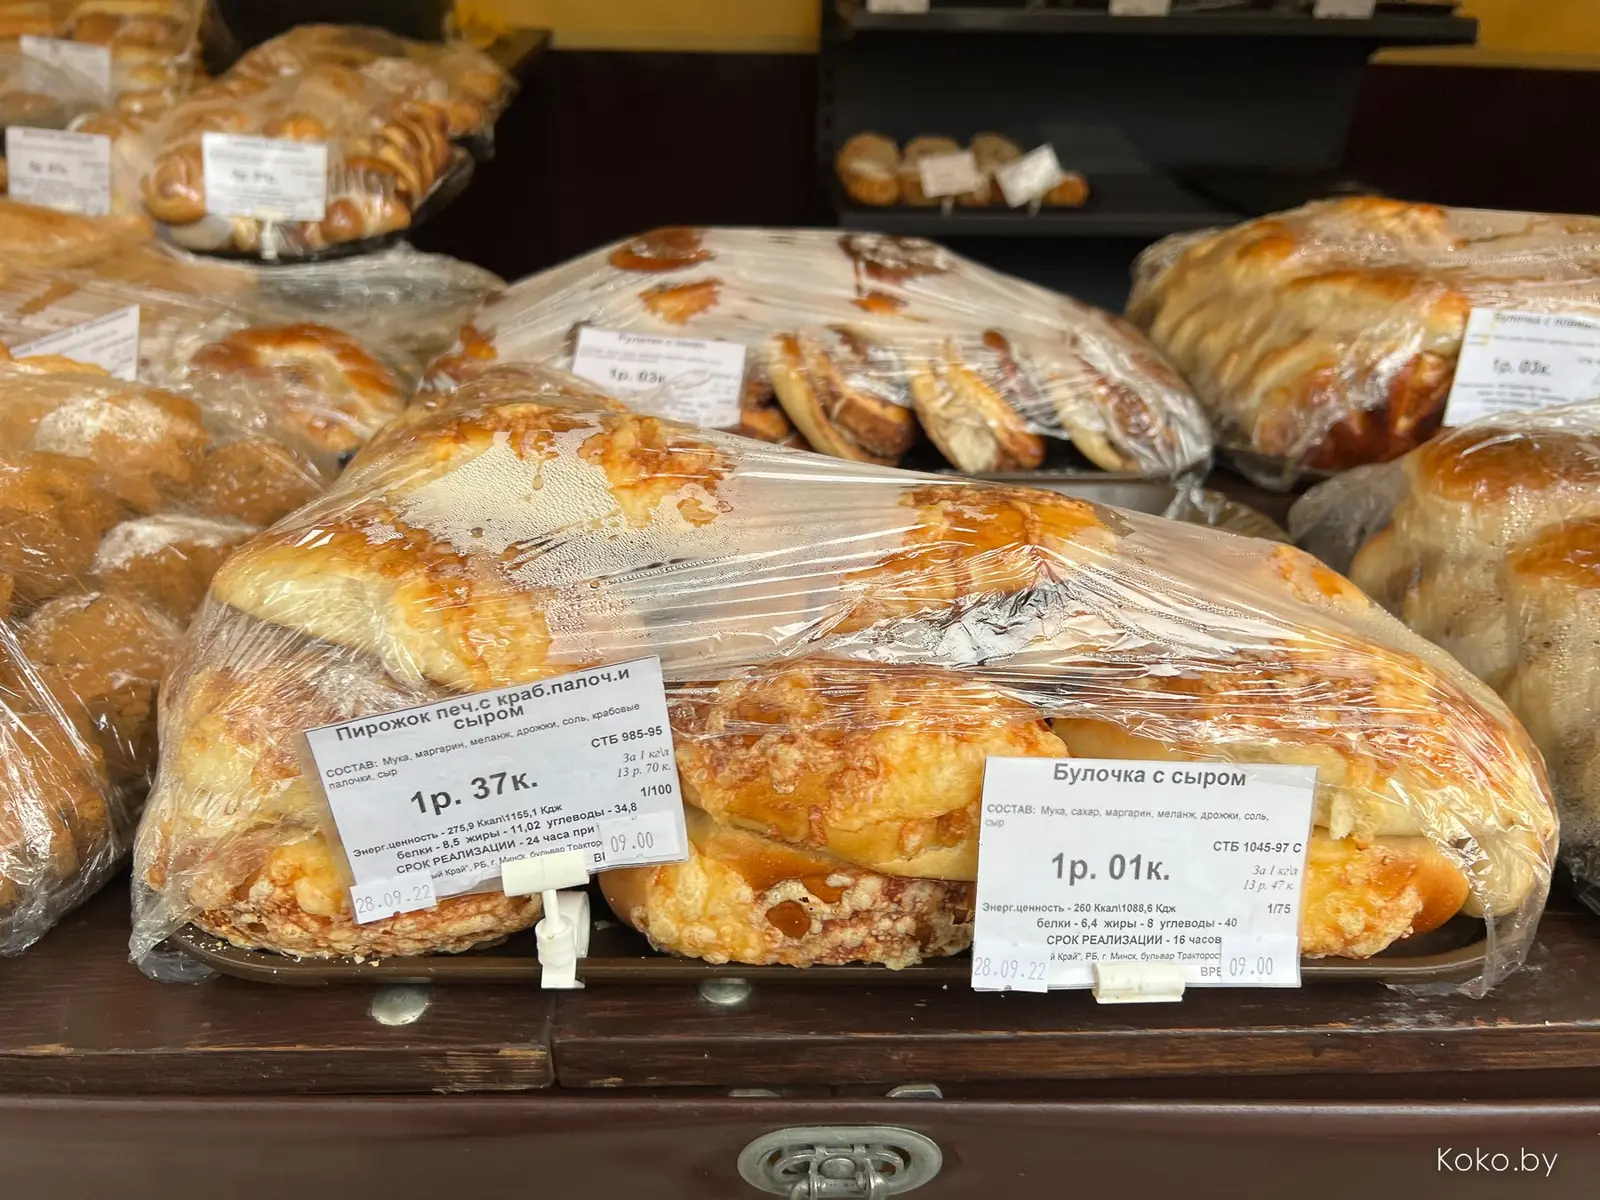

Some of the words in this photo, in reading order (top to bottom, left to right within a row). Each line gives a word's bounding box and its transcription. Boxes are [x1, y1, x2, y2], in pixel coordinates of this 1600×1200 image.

[336, 711, 431, 741] Пирожок
[436, 698, 491, 720] печ.с
[497, 669, 630, 706] краб.палоч.и
[454, 706, 524, 730] сыром
[326, 760, 378, 778] СОСТАВ:
[382, 753, 412, 767] Мука,
[415, 741, 468, 760] маргарин,
[470, 731, 513, 747] меланж,
[562, 714, 589, 726] соль,
[592, 703, 640, 720] крабовые
[591, 734, 618, 748] СТБ
[622, 726, 663, 742] 985-95
[623, 753, 636, 763] За
[640, 750, 644, 760] 1
[377, 768, 397, 779] сыр
[618, 768, 629, 778] 13
[633, 768, 642, 779] р.
[646, 763, 659, 773] 70
[662, 763, 671, 772] к.
[1053, 763, 1146, 785] Булочка
[1153, 770, 1165, 784] с
[1172, 770, 1246, 788] сыром
[411, 790, 461, 816] 1р.
[474, 771, 538, 800] 37к.
[640, 784, 672, 797] 1/100
[987, 804, 1036, 814] СОСТАВ:
[1041, 806, 1068, 817] Мука,
[1071, 807, 1101, 817] сахар,
[1105, 809, 1154, 819] маргарин,
[1157, 810, 1197, 820] меланж,
[1244, 812, 1269, 822] соль,
[353, 832, 438, 857] Энерг.ценность
[447, 821, 475, 836] 275,9
[477, 808, 537, 828] Ккал\1155,1
[541, 804, 562, 816] Кдж
[396, 845, 433, 860] белки
[442, 838, 460, 849] 8,5
[466, 830, 500, 843] жиры
[510, 820, 541, 834] 11,02
[547, 809, 604, 829] углеводы
[615, 802, 637, 814] 34,8
[985, 818, 1004, 827] сыр
[396, 859, 431, 874] СРОК
[433, 840, 516, 866] РЕАЛИЗАЦИИ
[526, 836, 539, 846] 24
[543, 831, 569, 842] часа
[573, 826, 595, 838] при
[610, 832, 654, 853] 09.00
[1213, 840, 1239, 852] СТБ
[1243, 842, 1289, 853] 1045-97
[1293, 842, 1302, 853] С
[474, 860, 490, 870] РБ,
[1052, 852, 1096, 886] 1р.
[1109, 854, 1169, 880] 01к.
[1252, 864, 1265, 875] За
[1243, 879, 1255, 890] 13
[1257, 882, 1267, 892] р.
[1271, 880, 1285, 890] 47
[1286, 883, 1294, 891] к.
[355, 884, 432, 914] 28.09.22
[982, 902, 1064, 913] Энерг.ценность
[1074, 904, 1090, 913] 260
[1094, 904, 1153, 913] Ккал\1088,6
[1156, 904, 1176, 913] Кдж
[1267, 903, 1291, 914] 1/75
[1036, 918, 1071, 928] белки
[1081, 918, 1098, 929] 6,4
[1104, 919, 1137, 930] жиры
[1147, 918, 1154, 928] 8
[1160, 919, 1215, 930] углеводы
[1225, 918, 1237, 927] 40
[1047, 935, 1078, 945] СРОК
[1082, 935, 1163, 946] РЕАЛИЗАЦИИ
[1173, 935, 1185, 945] 16
[1189, 936, 1222, 944] часов
[1085, 952, 1100, 961] РБ,
[1110, 952, 1138, 961] Минск,
[1141, 952, 1175, 961] бульвар
[974, 957, 1046, 980] 28.09.22
[1230, 956, 1273, 976] 09.00
